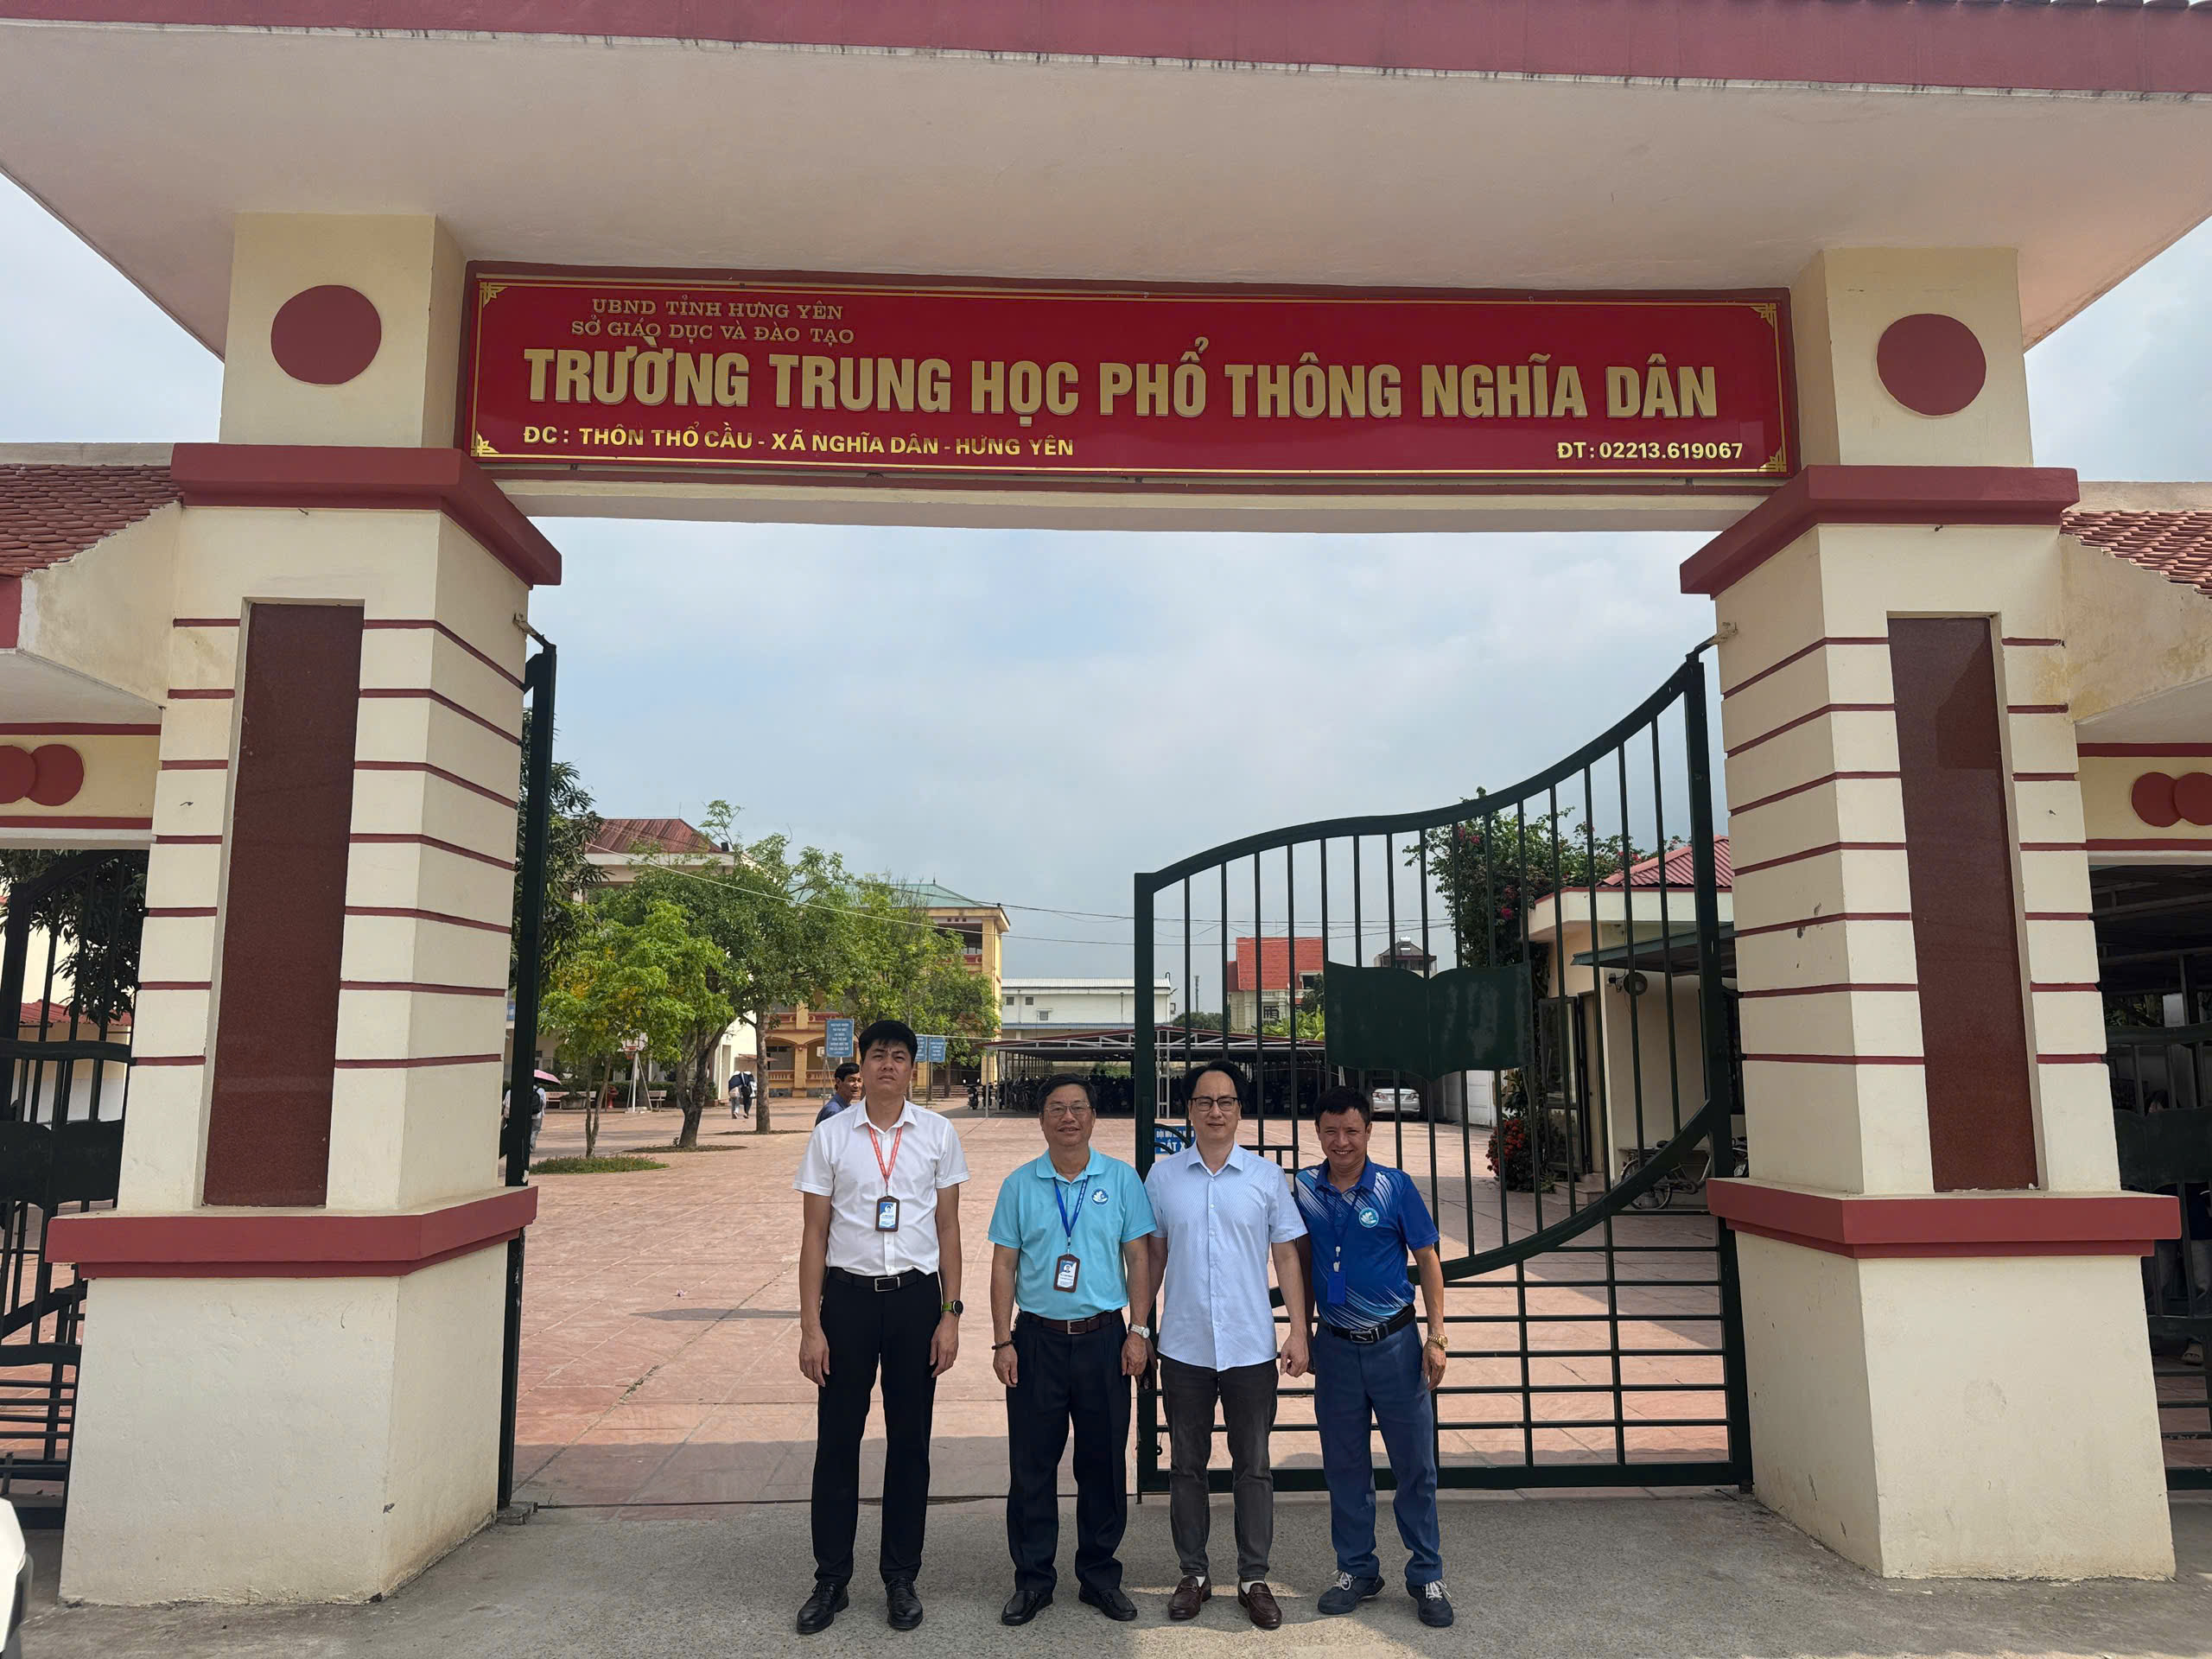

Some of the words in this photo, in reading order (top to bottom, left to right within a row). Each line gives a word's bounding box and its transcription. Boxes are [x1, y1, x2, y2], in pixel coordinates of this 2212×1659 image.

[592, 298, 657, 315] UBND
[665, 294, 722, 317] TỈNH
[728, 301, 790, 319] HƯNG
[797, 300, 843, 321] YÊN
[571, 314, 601, 336] SỞ
[607, 317, 662, 338] GIÁO
[668, 323, 713, 345] DỤC
[720, 320, 747, 340] VÀ
[753, 321, 801, 342] ĐÀO
[810, 327, 855, 347] TẠO
[524, 335, 750, 407] TRƯỜNG
[769, 353, 951, 413] TRUNG
[970, 359, 1079, 427] HỌC
[1099, 336, 1209, 418] PHỔ
[1224, 352, 1402, 418] THÔNG
[1421, 353, 1588, 418] NGHĨA
[1605, 353, 1718, 418] DÂN
[579, 423, 644, 447] THÔN
[651, 421, 700, 448] THỔ
[704, 422, 753, 449] CẦU
[771, 429, 806, 452] XÃ
[811, 431, 885, 454] NGHĨA
[890, 433, 939, 455] DÂN
[956, 435, 1021, 456] HƯNG
[1028, 435, 1074, 456] YÊN
